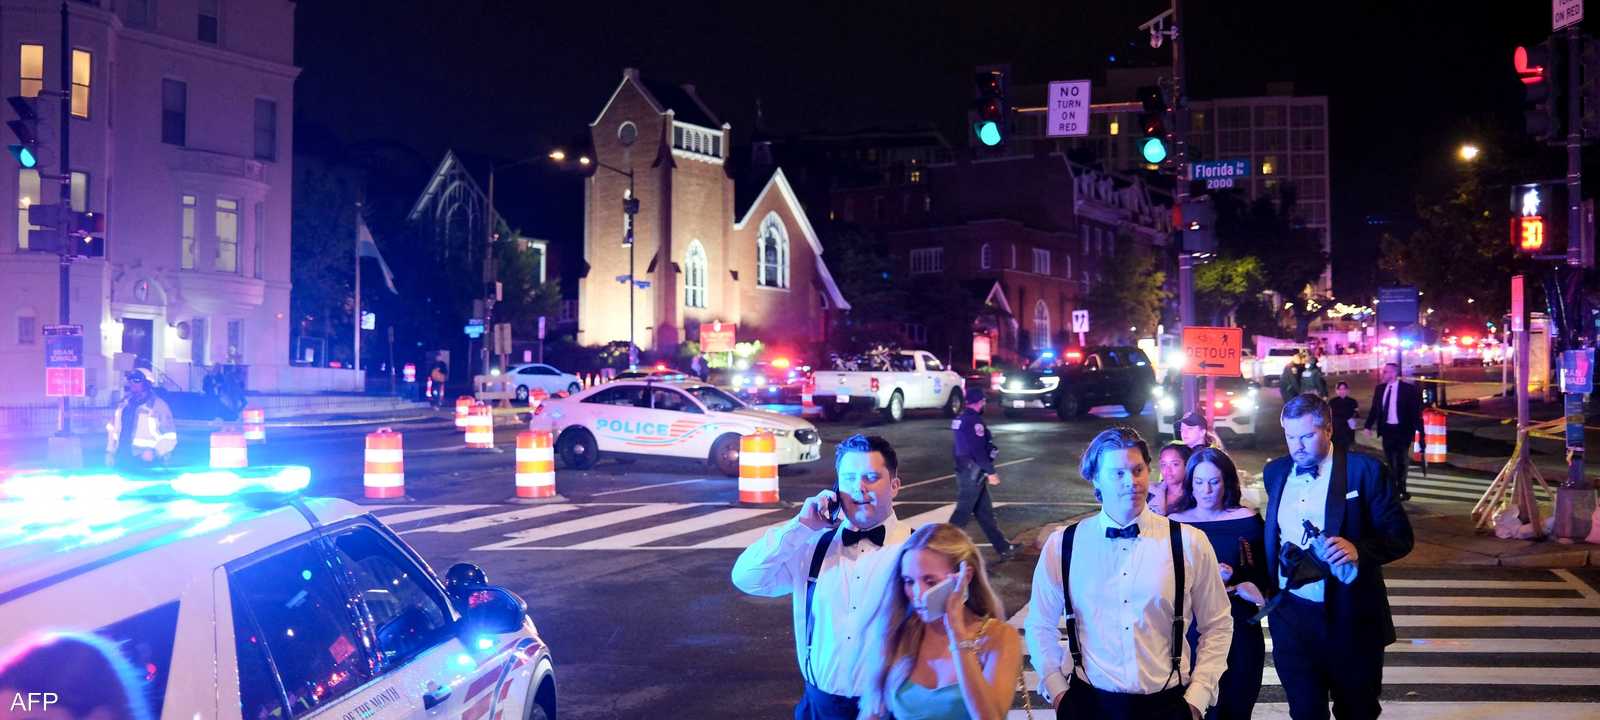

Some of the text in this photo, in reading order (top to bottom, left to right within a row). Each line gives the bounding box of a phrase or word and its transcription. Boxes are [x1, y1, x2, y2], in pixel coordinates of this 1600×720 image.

[1060, 86, 1079, 97] NO
[1057, 100, 1081, 109] TURN
[1061, 111, 1075, 120] ON
[1059, 122, 1077, 131] RED
[1195, 163, 1234, 178] Florida
[1207, 178, 1233, 189] 2000
[1521, 219, 1543, 248] 30
[1186, 346, 1235, 359] DETOUR
[596, 418, 669, 436] POLICE
[355, 703, 374, 718] THE
[369, 686, 400, 709] MONTH
